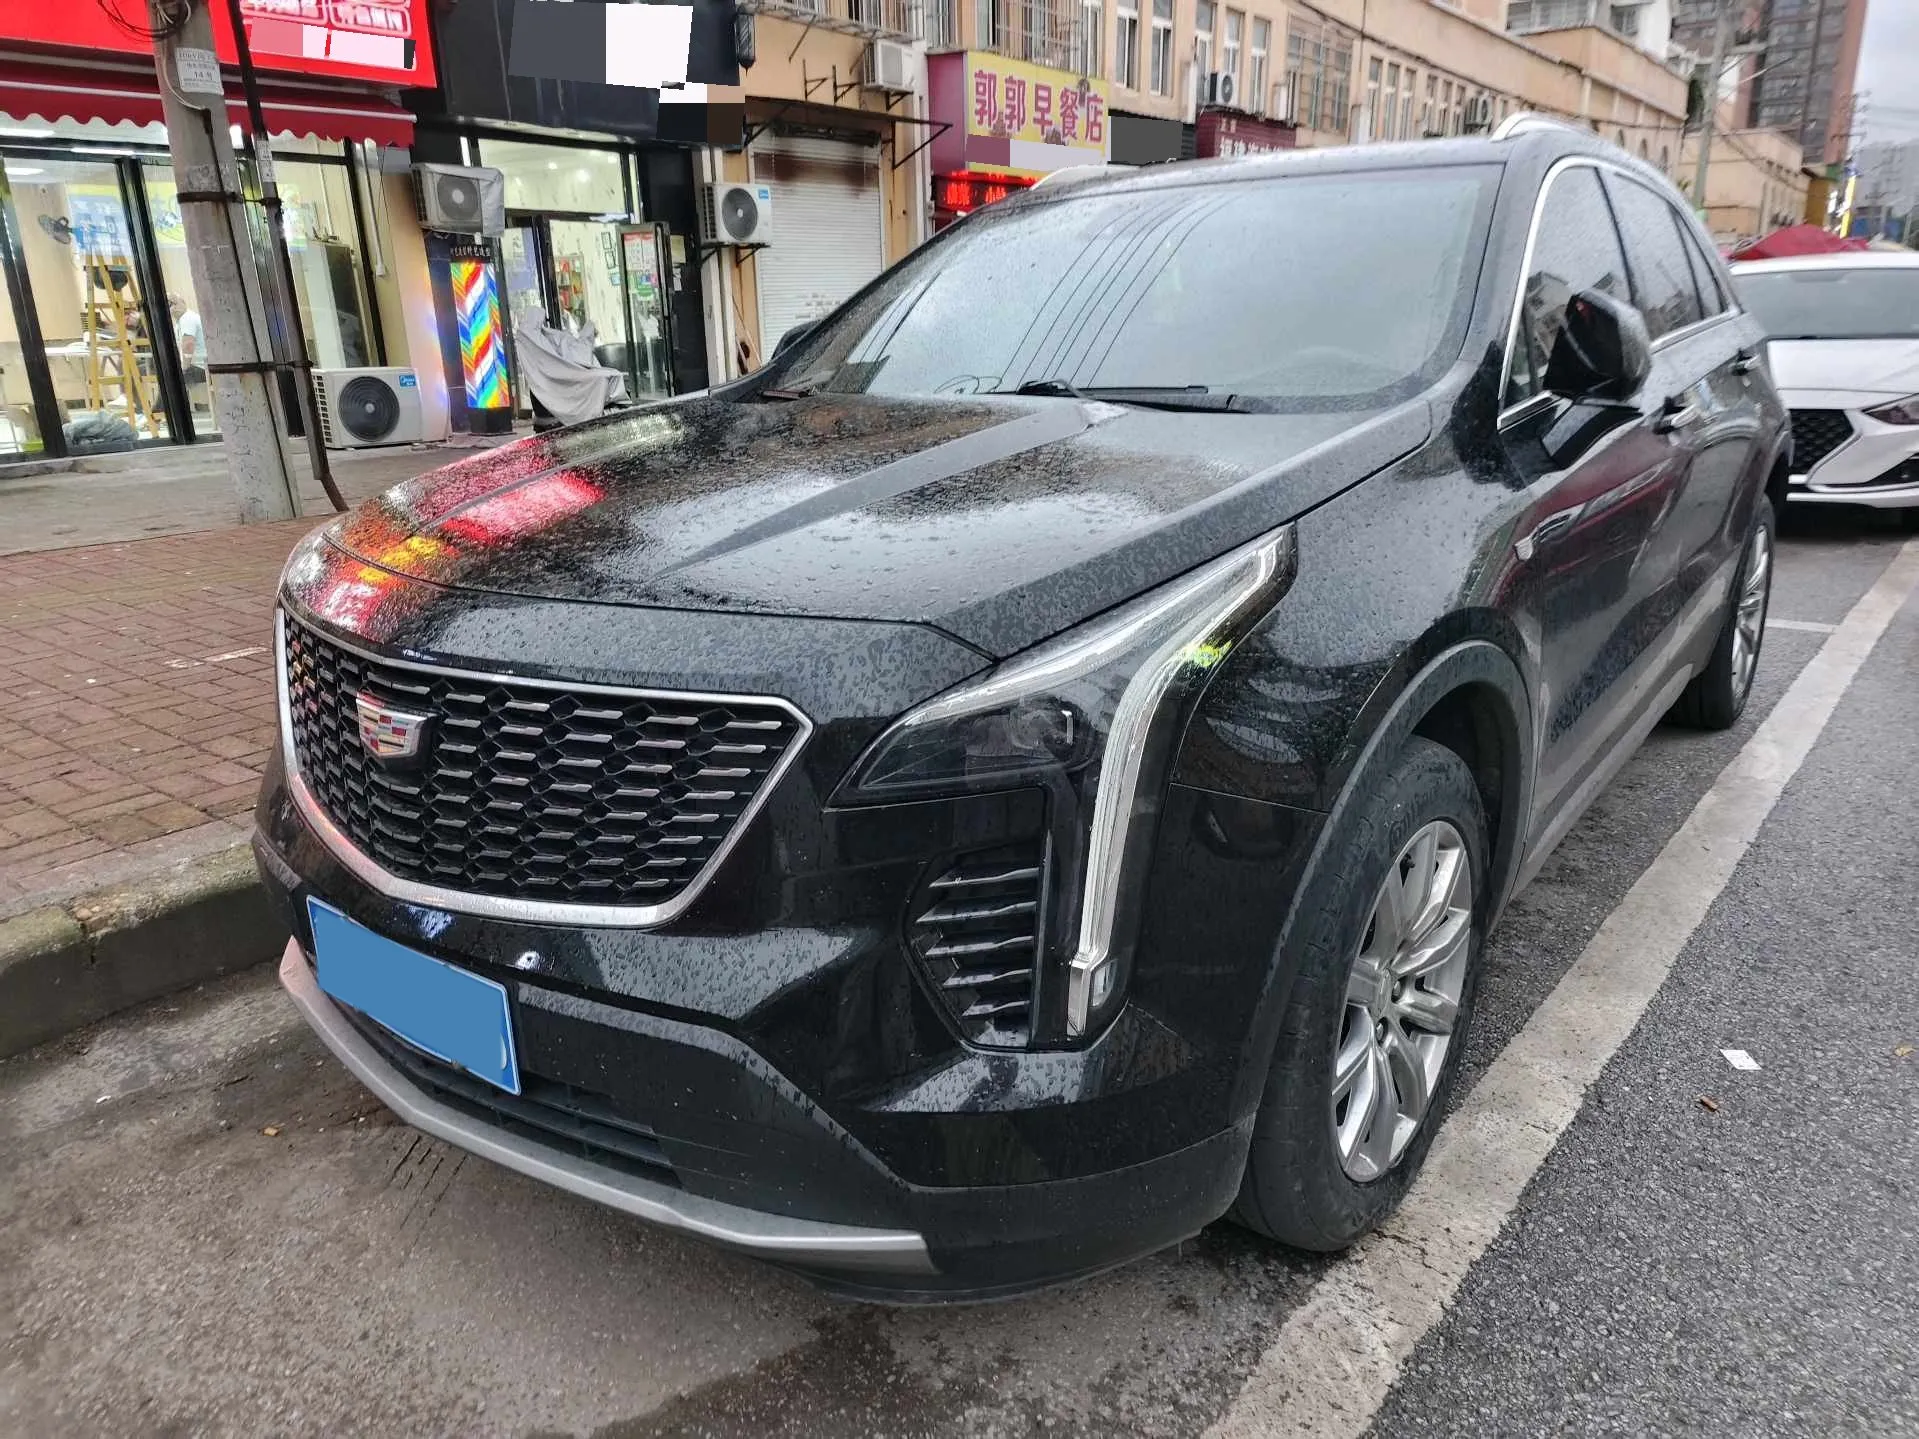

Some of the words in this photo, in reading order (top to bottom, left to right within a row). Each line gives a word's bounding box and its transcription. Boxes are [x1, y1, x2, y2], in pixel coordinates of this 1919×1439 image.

[974, 70, 1104, 143] 郭郭早餐店
